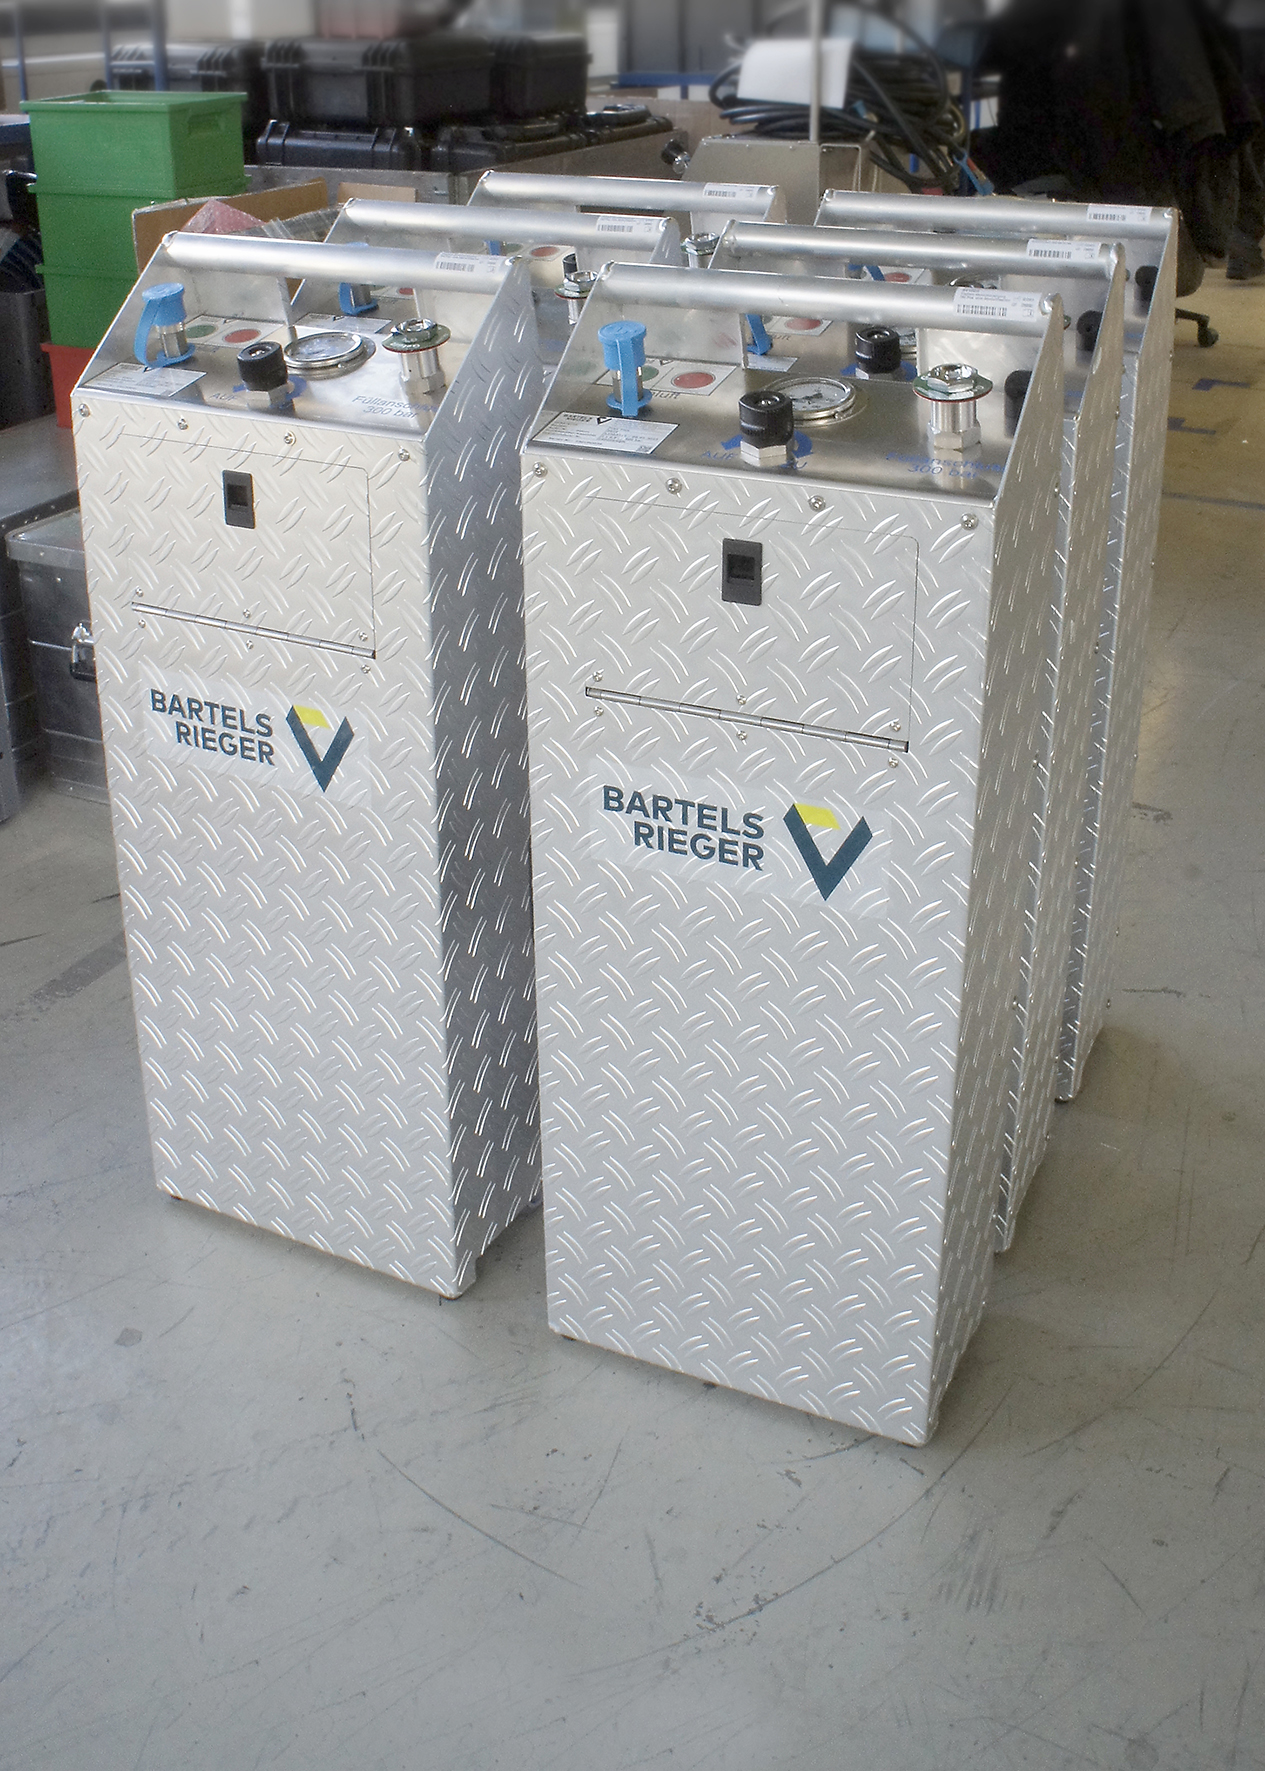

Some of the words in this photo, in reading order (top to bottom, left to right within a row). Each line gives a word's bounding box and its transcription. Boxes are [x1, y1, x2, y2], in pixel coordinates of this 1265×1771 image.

[363, 405, 393, 415] 300
[394, 410, 419, 419] bar
[700, 450, 738, 461] AUF
[907, 464, 943, 475] 300
[949, 469, 979, 480] bar
[150, 688, 274, 737] BARTELS
[175, 720, 276, 767] RIEGER
[603, 785, 765, 840] BARTELS
[633, 820, 765, 872] RIEGER
